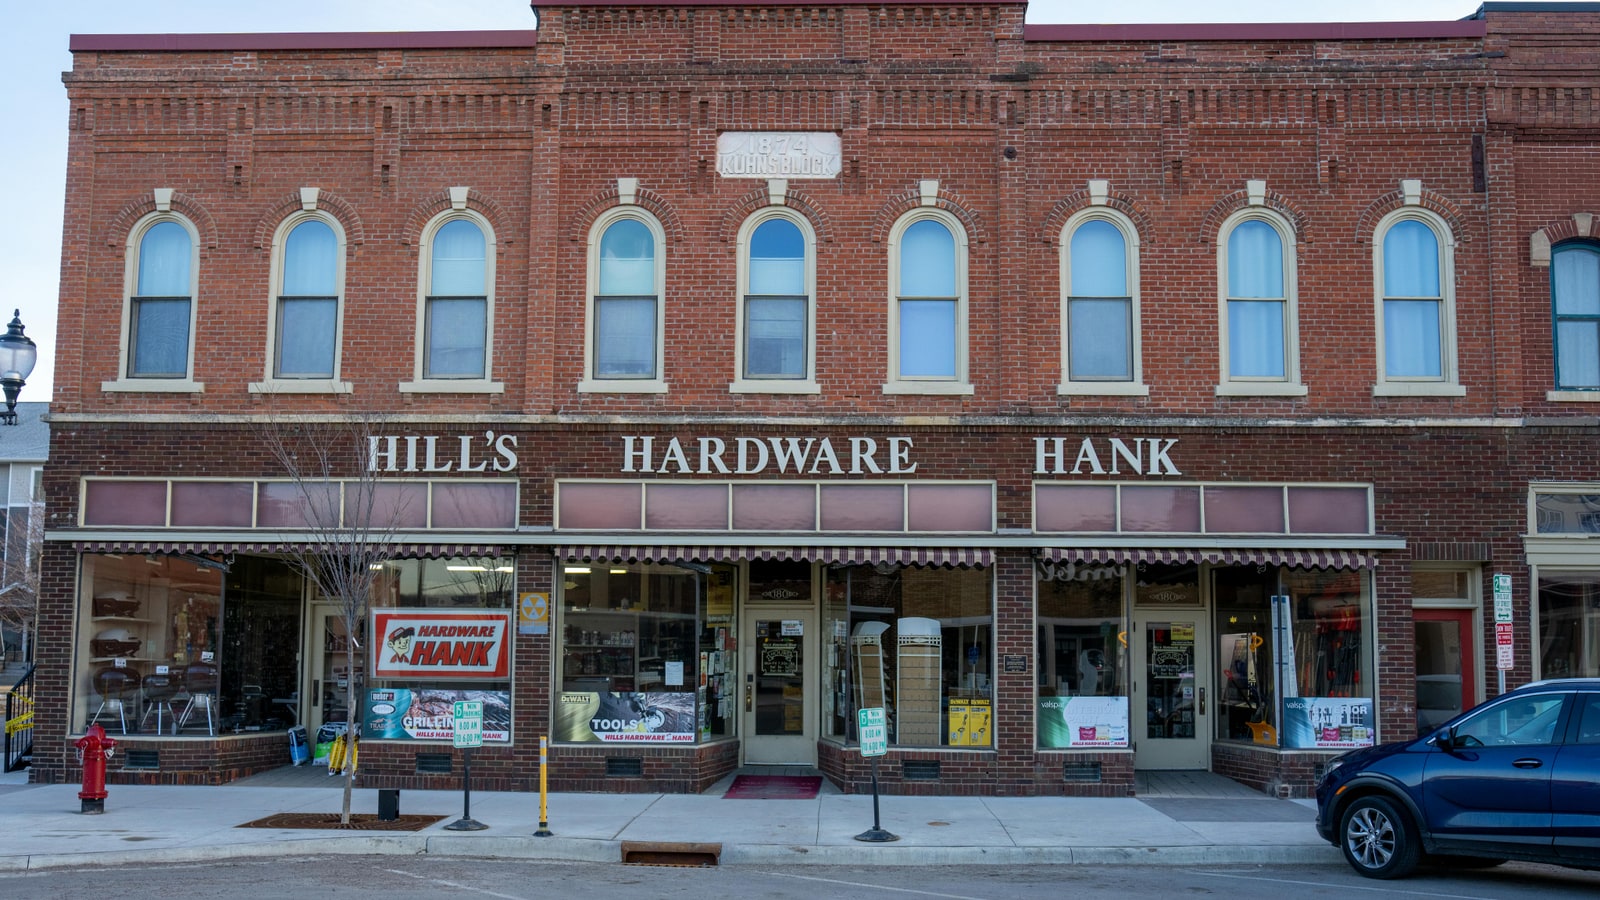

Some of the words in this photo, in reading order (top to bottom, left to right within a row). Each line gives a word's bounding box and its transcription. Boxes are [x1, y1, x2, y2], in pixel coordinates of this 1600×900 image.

[749, 135, 808, 155] 1874
[782, 156, 834, 175] BLOCK
[367, 430, 518, 472] HILL'S
[620, 436, 918, 475] HARDWARE
[1033, 436, 1182, 475] HANK
[418, 625, 496, 637] HARDWARE
[409, 641, 496, 666] HANK
[1041, 701, 1064, 709] valspa
[1312, 705, 1367, 714] EXTERIOR
[471, 721, 477, 729] AM
[591, 719, 638, 730] TOOLS
